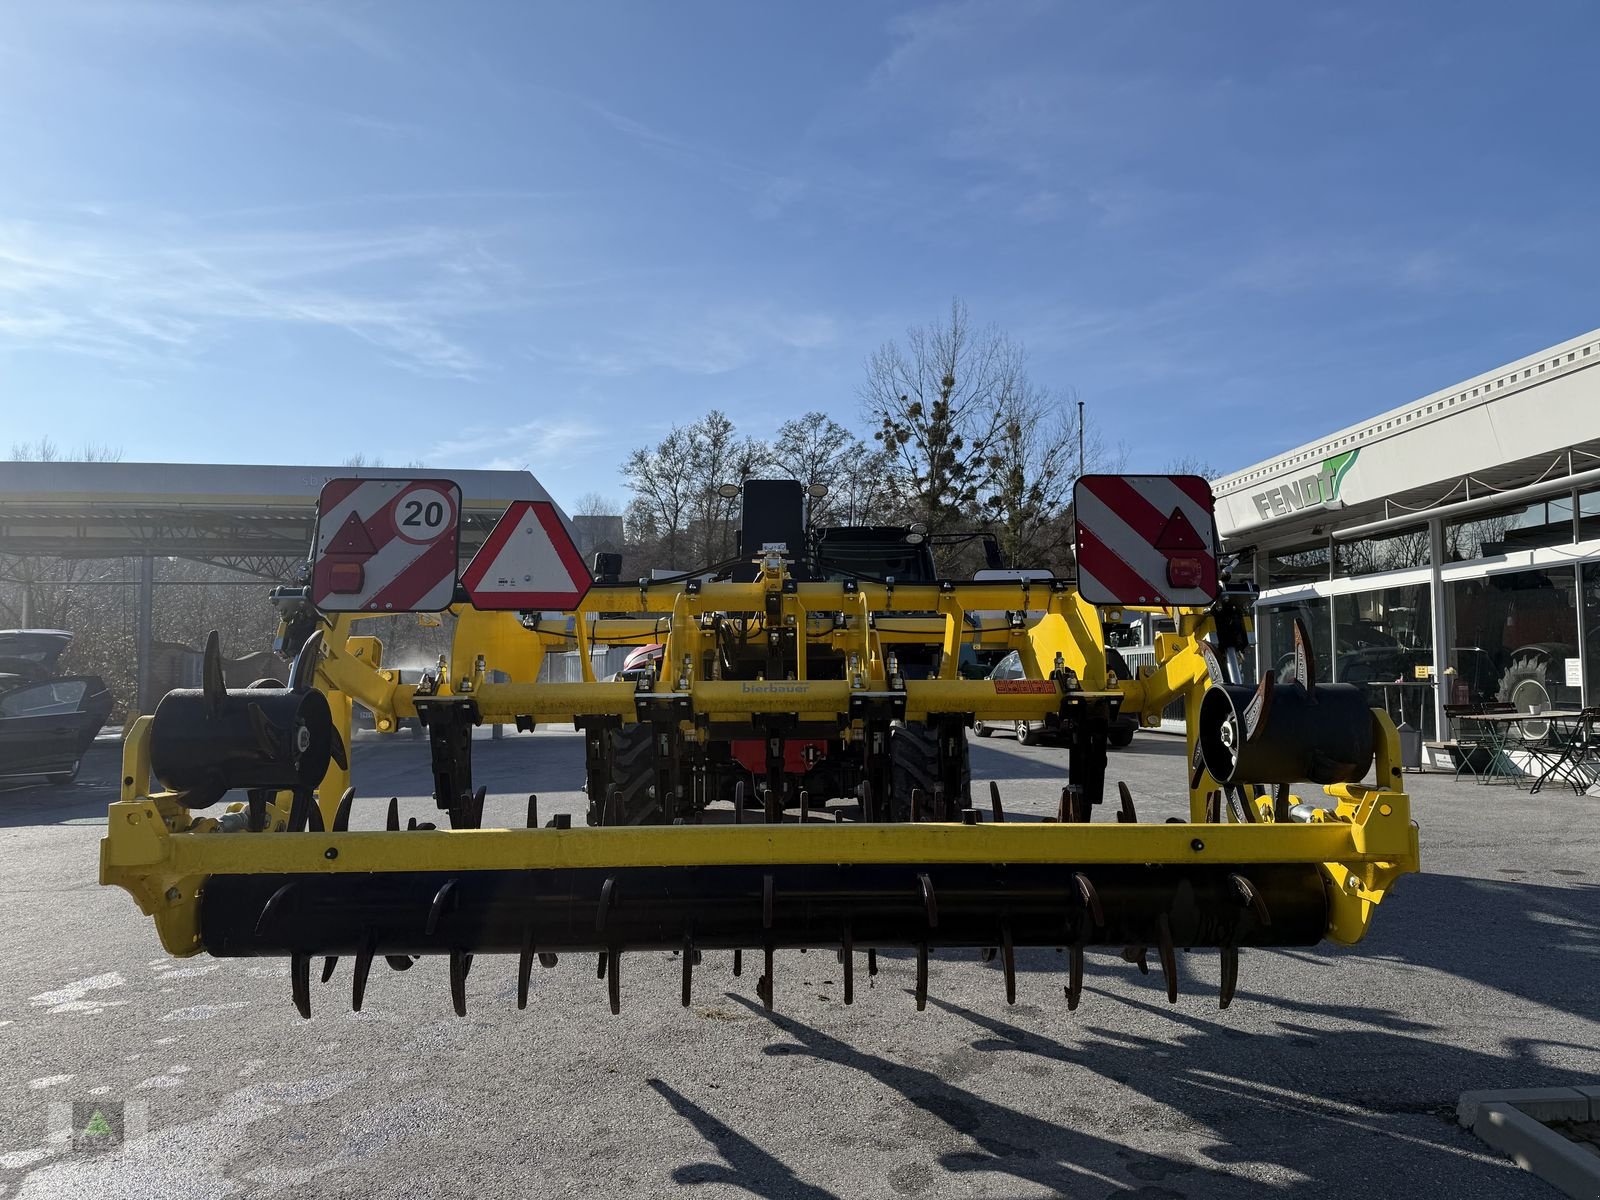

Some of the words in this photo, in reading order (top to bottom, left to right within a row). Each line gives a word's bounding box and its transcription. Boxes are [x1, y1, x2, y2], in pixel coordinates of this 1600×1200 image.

[1252, 468, 1336, 520] FENDT
[402, 500, 444, 527] 20
[743, 683, 807, 693] bierbauer
